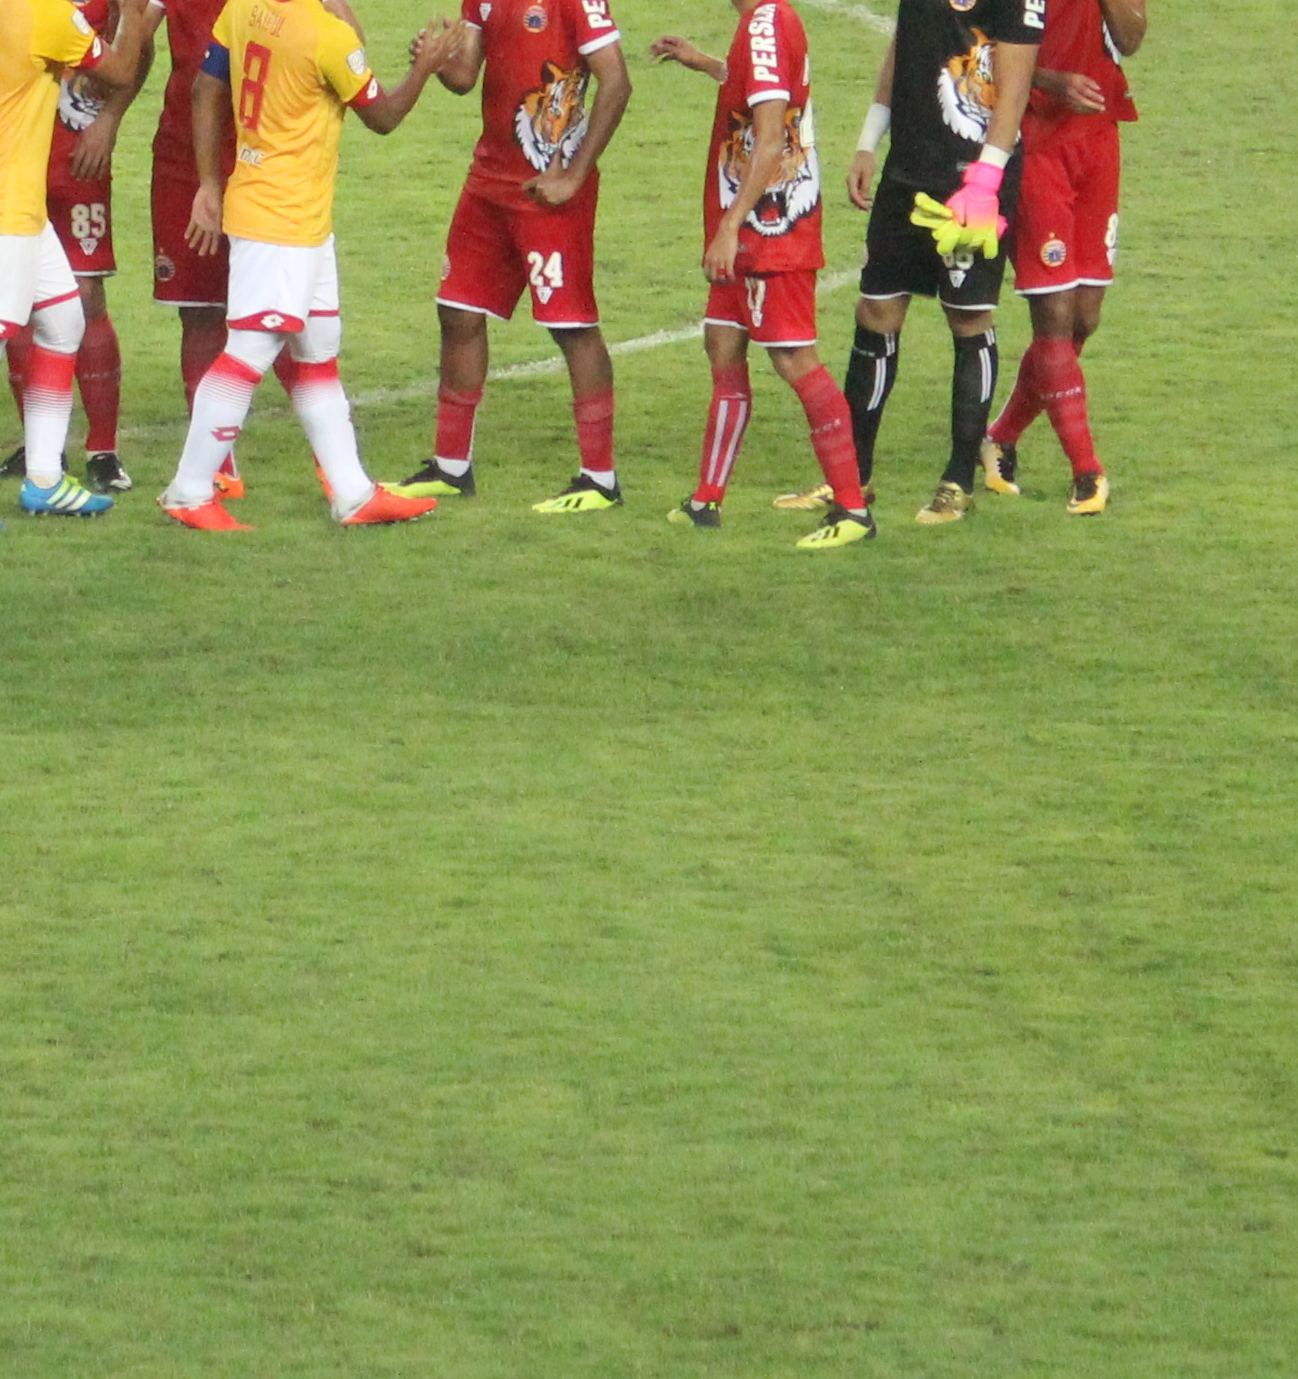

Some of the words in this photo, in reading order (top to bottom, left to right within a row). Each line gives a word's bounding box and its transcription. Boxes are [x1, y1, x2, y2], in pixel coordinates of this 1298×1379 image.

[239, 39, 273, 131] 8
[70, 203, 107, 239] 85
[527, 250, 565, 288] 24
